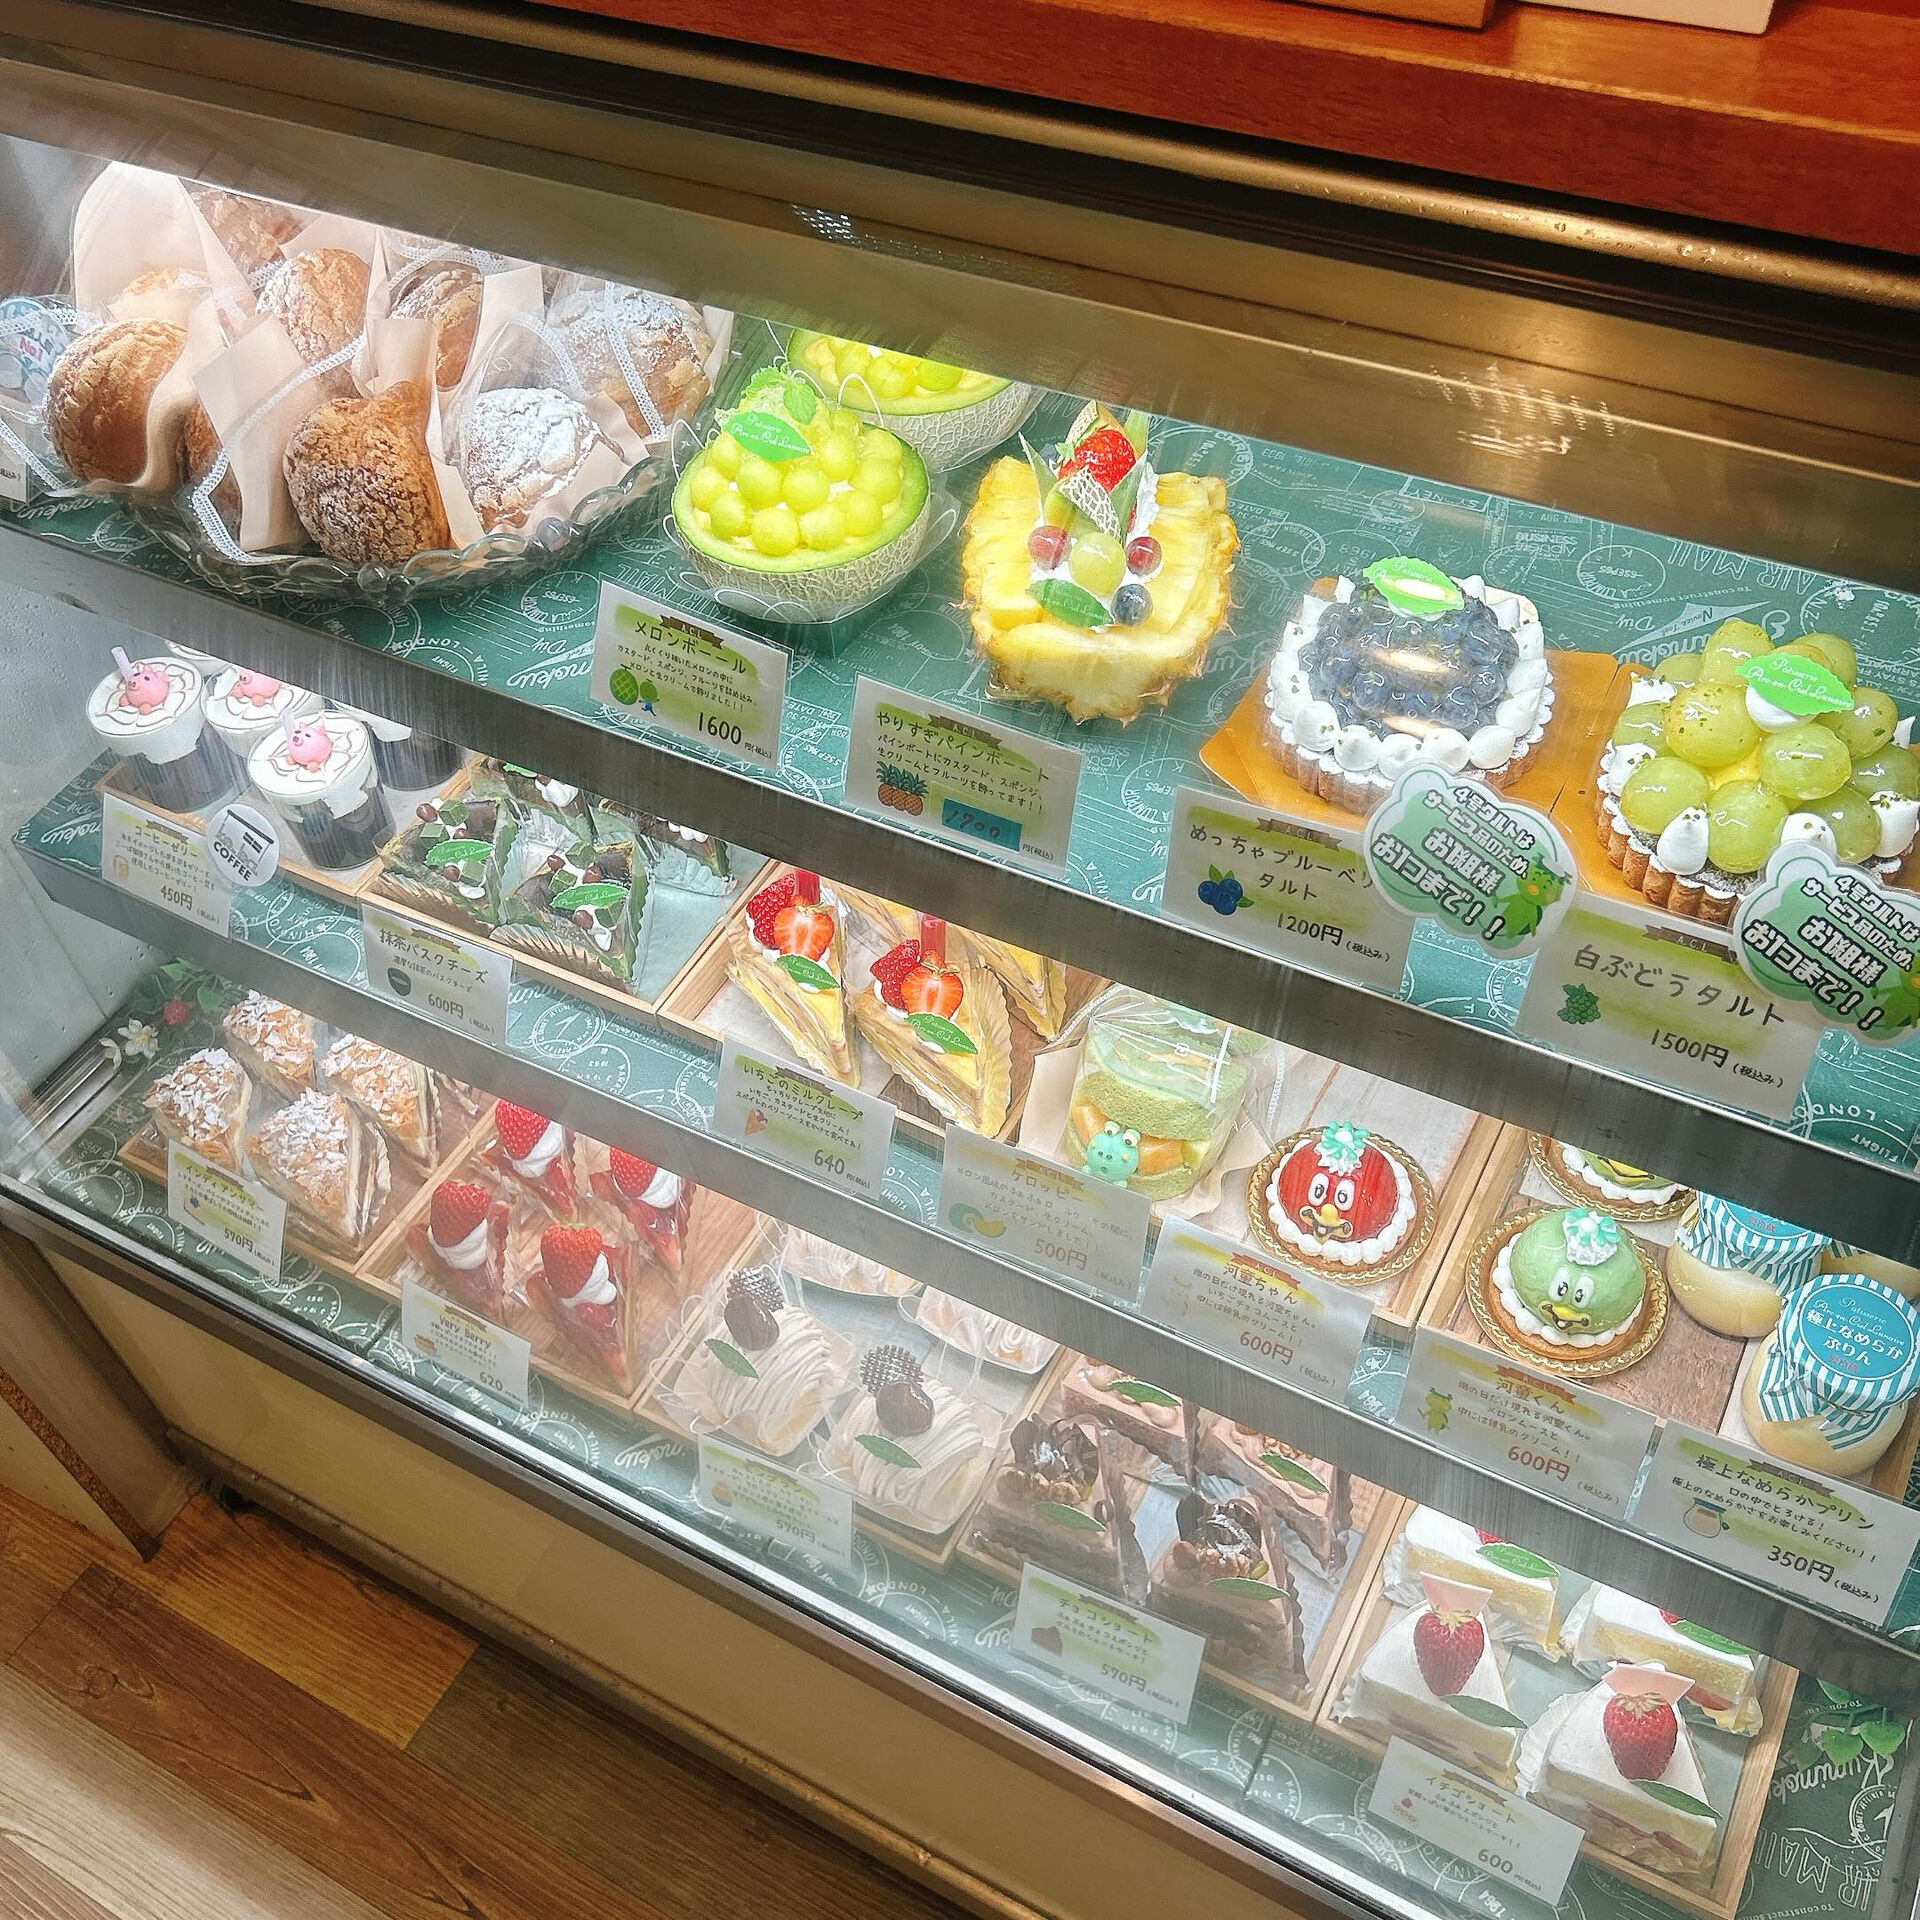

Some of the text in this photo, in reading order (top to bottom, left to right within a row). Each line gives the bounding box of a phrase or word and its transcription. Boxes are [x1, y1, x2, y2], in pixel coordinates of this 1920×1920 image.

[1667, 537, 1816, 595] AIR MAIL
[1615, 614, 1654, 632] Diy
[431, 655, 460, 674] FLIGHT
[530, 637, 567, 657] Diy
[698, 711, 742, 745] 1600
[1453, 785, 1536, 851] 4号タルトは
[213, 841, 252, 882] COFFEE
[160, 885, 193, 911] 450円
[1258, 872, 1319, 902] タルト
[1278, 913, 1344, 947] 1200円
[379, 927, 489, 984] 抹茶バスクチーズ
[1574, 943, 1785, 1026] 白ぶどうタルト
[427, 992, 464, 1020] 600円
[1651, 1028, 1730, 1069] 1500円
[742, 1062, 865, 1121] いちごのミルクレープ
[813, 1148, 846, 1176] 640
[1850, 1132, 1899, 1163] FLIGHT
[1011, 1168, 1084, 1203] ケロッピー
[1034, 1238, 1089, 1271] 500円
[1222, 1262, 1298, 1305] 河童ちゃん
[439, 1315, 460, 1334] Very
[1806, 1308, 1903, 1360] 極上なめらか
[1239, 1331, 1294, 1366] 600円
[480, 1371, 503, 1391] 620
[1495, 1378, 1565, 1415] 河童くん
[1507, 1445, 1571, 1482] 600円
[1695, 1453, 1875, 1531] 極上なめらかプリン
[1767, 1545, 1836, 1583] 350円
[1059, 1597, 1153, 1644] チョコショート
[1100, 1662, 1147, 1692] 570円
[1426, 1775, 1517, 1825] イチゴショート
[1477, 1848, 1514, 1876] 600
